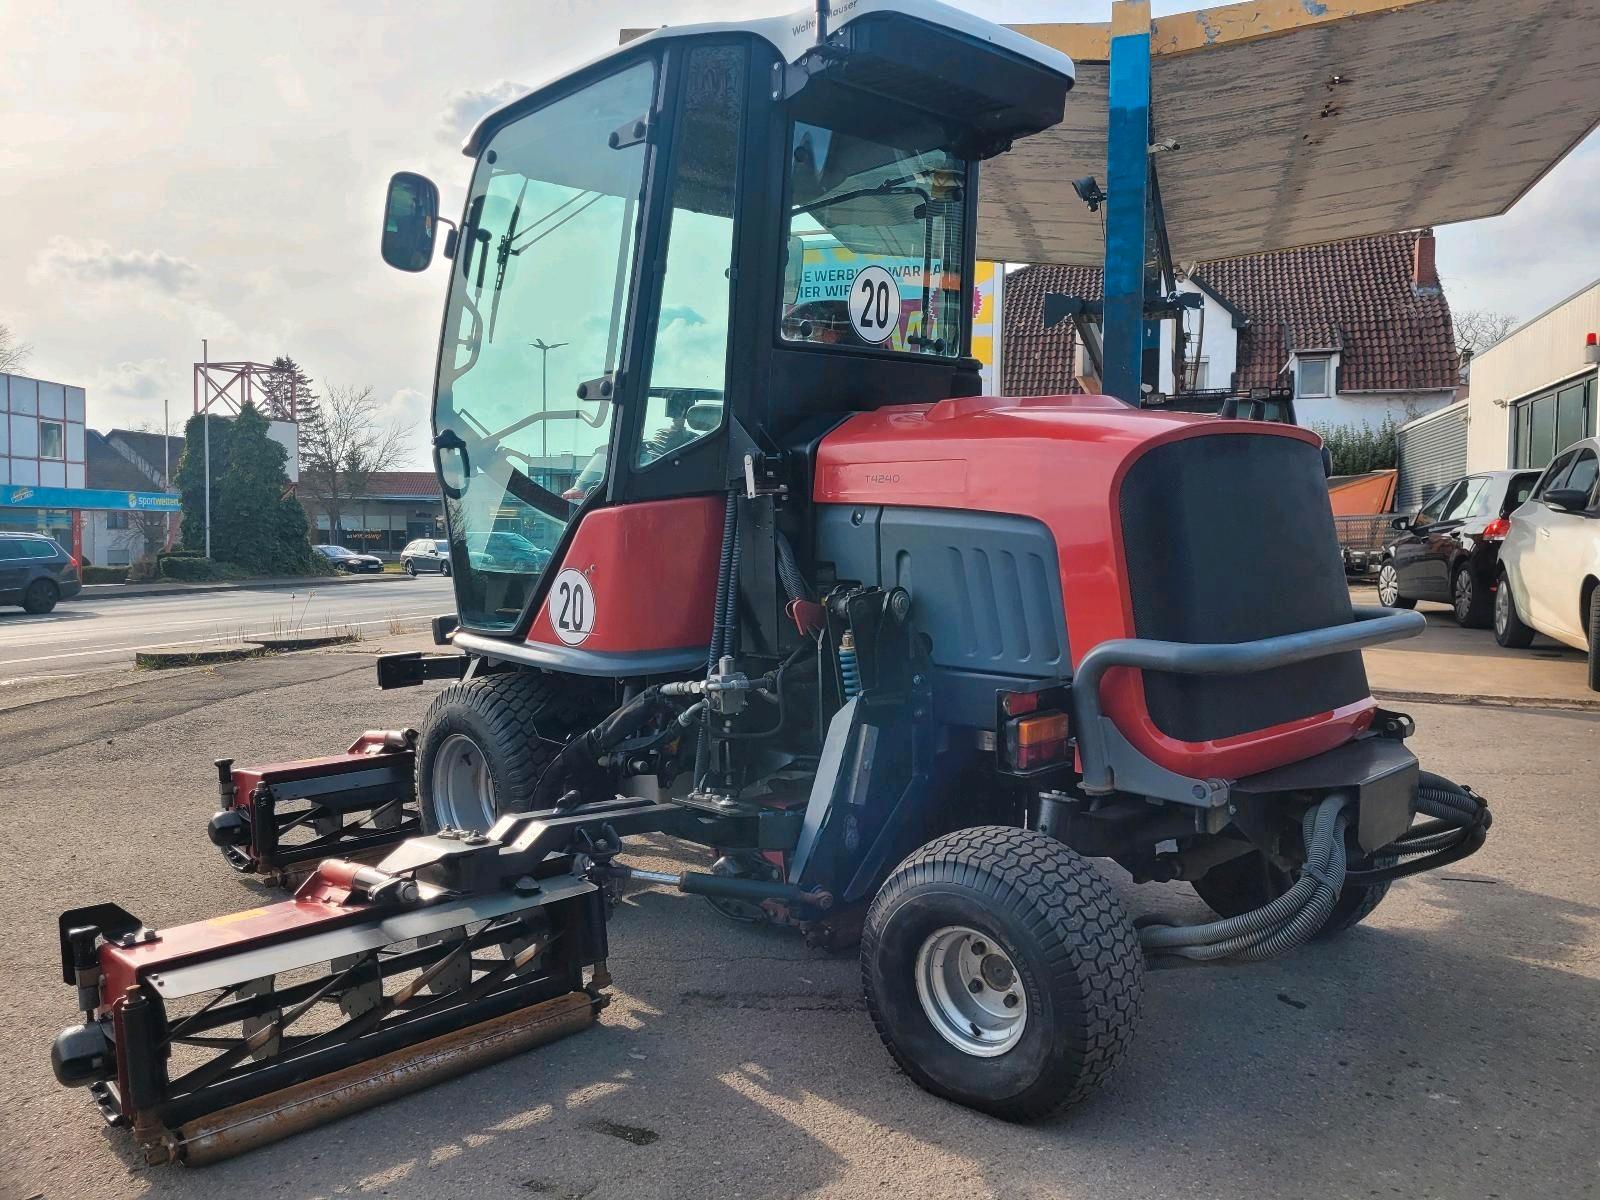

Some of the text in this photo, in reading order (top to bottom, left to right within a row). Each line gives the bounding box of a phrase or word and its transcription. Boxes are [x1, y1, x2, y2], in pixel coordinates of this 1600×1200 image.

[792, 18, 817, 37] Walte
[814, 268, 858, 282] WERB
[861, 278, 889, 328] 20
[864, 474, 900, 484] T4240
[558, 581, 584, 630] 20
